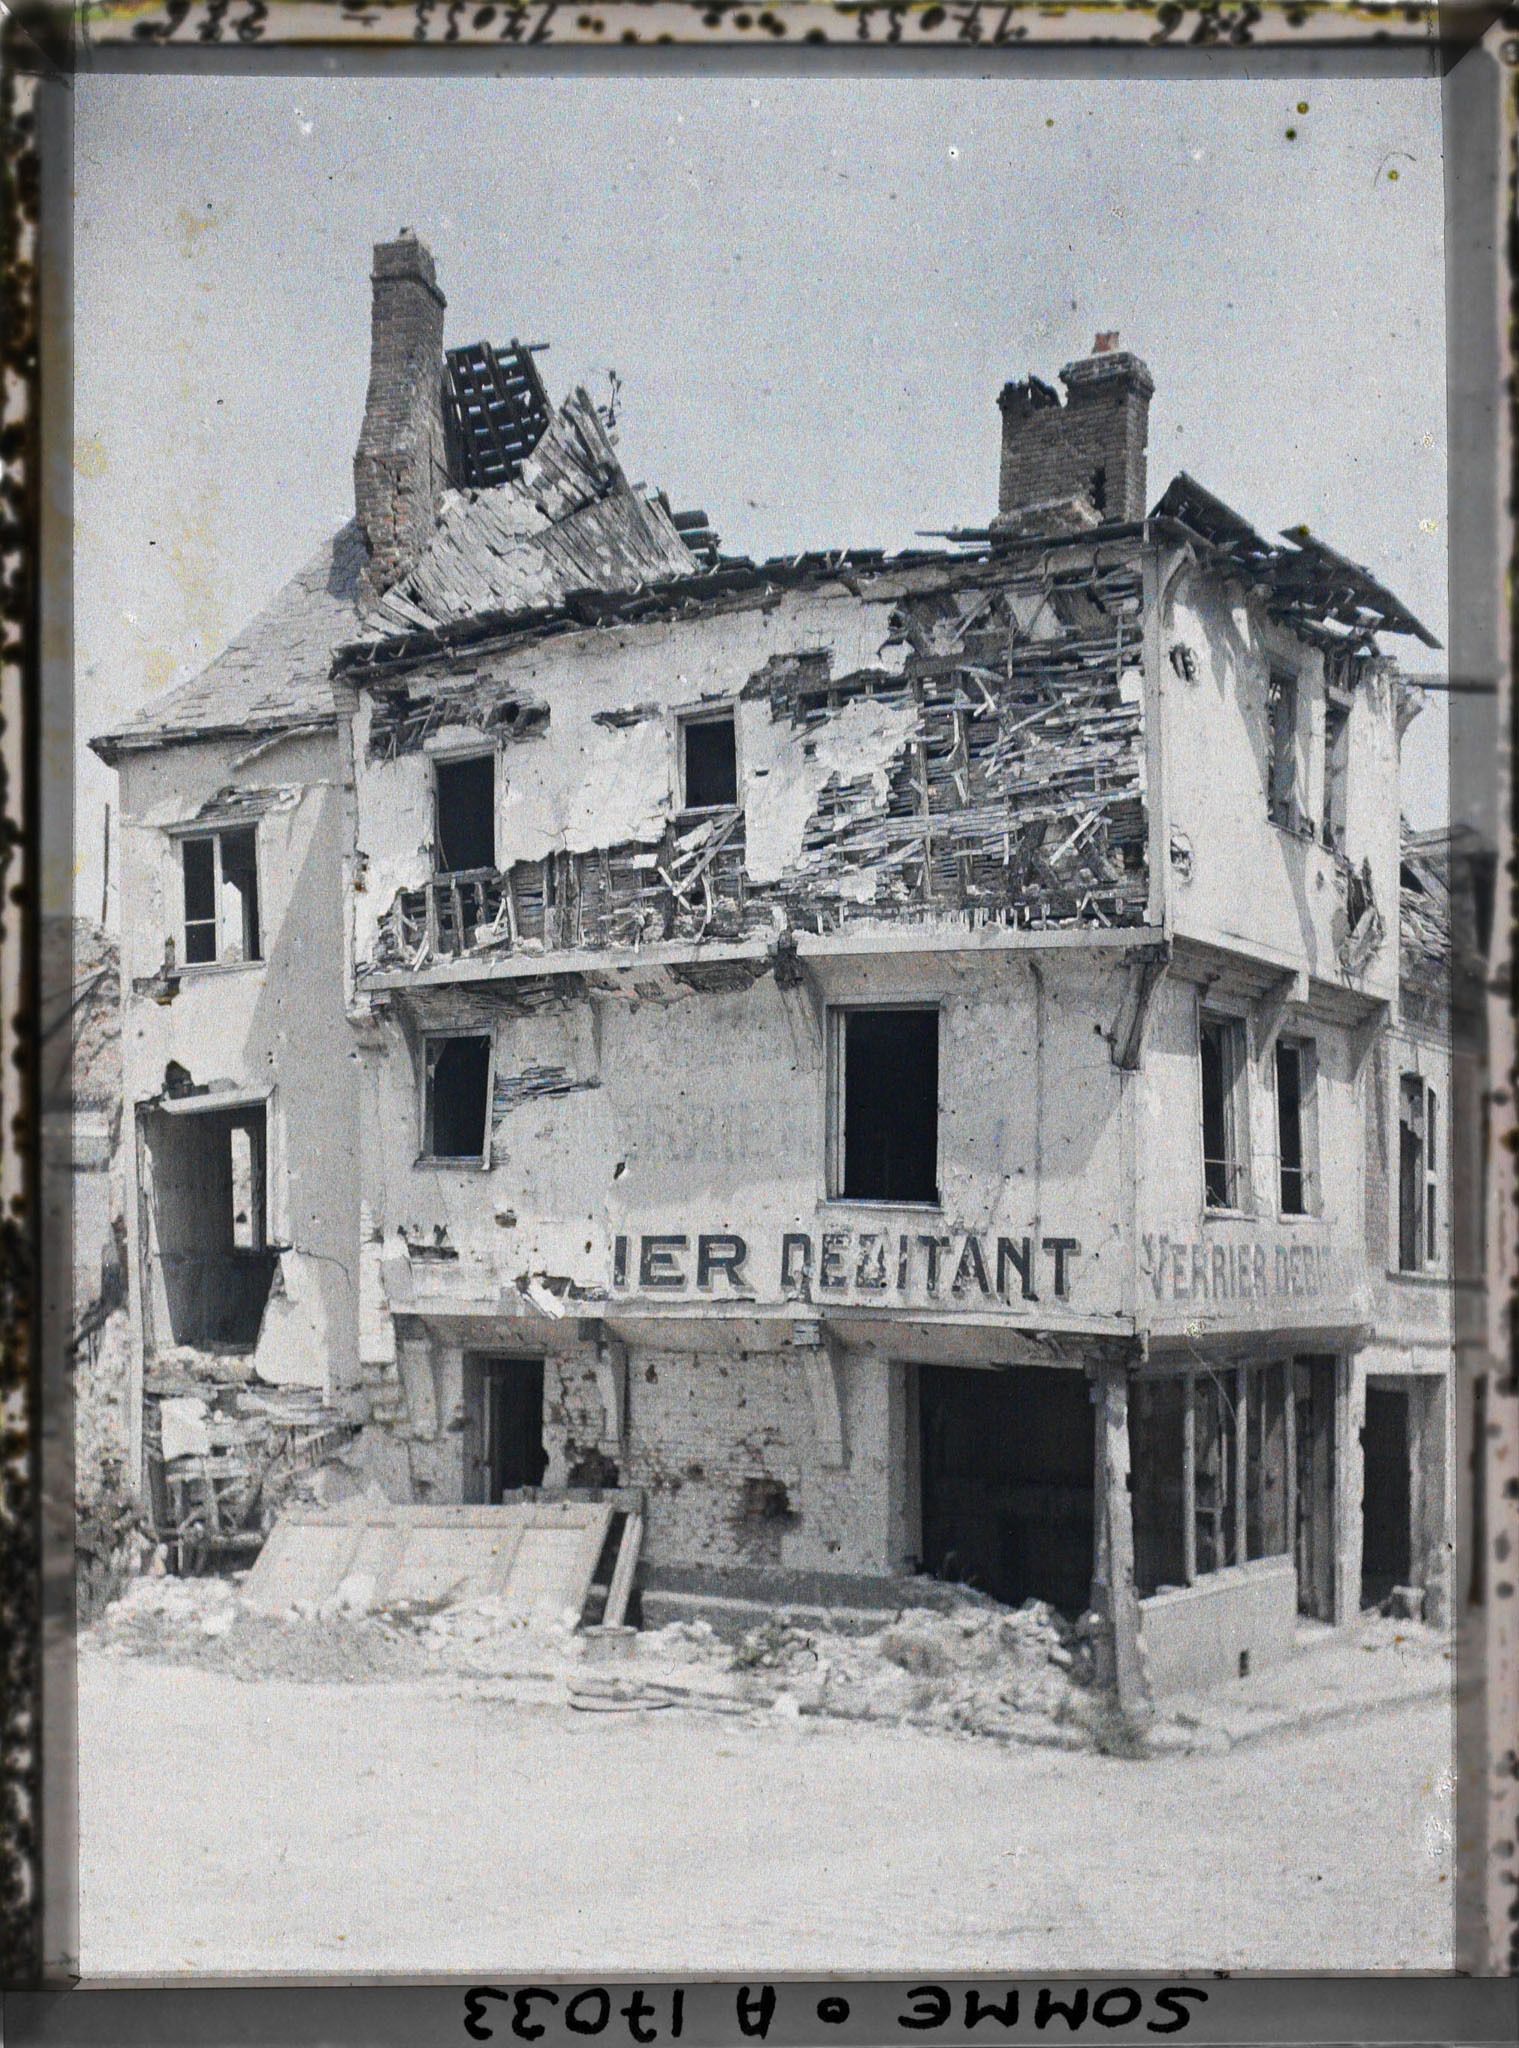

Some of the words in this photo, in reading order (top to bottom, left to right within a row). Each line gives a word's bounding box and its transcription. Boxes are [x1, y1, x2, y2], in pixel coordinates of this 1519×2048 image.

[463, 1985, 685, 2044] 17033
[736, 1984, 777, 2040] A
[897, 1984, 1209, 2033] SOMME
